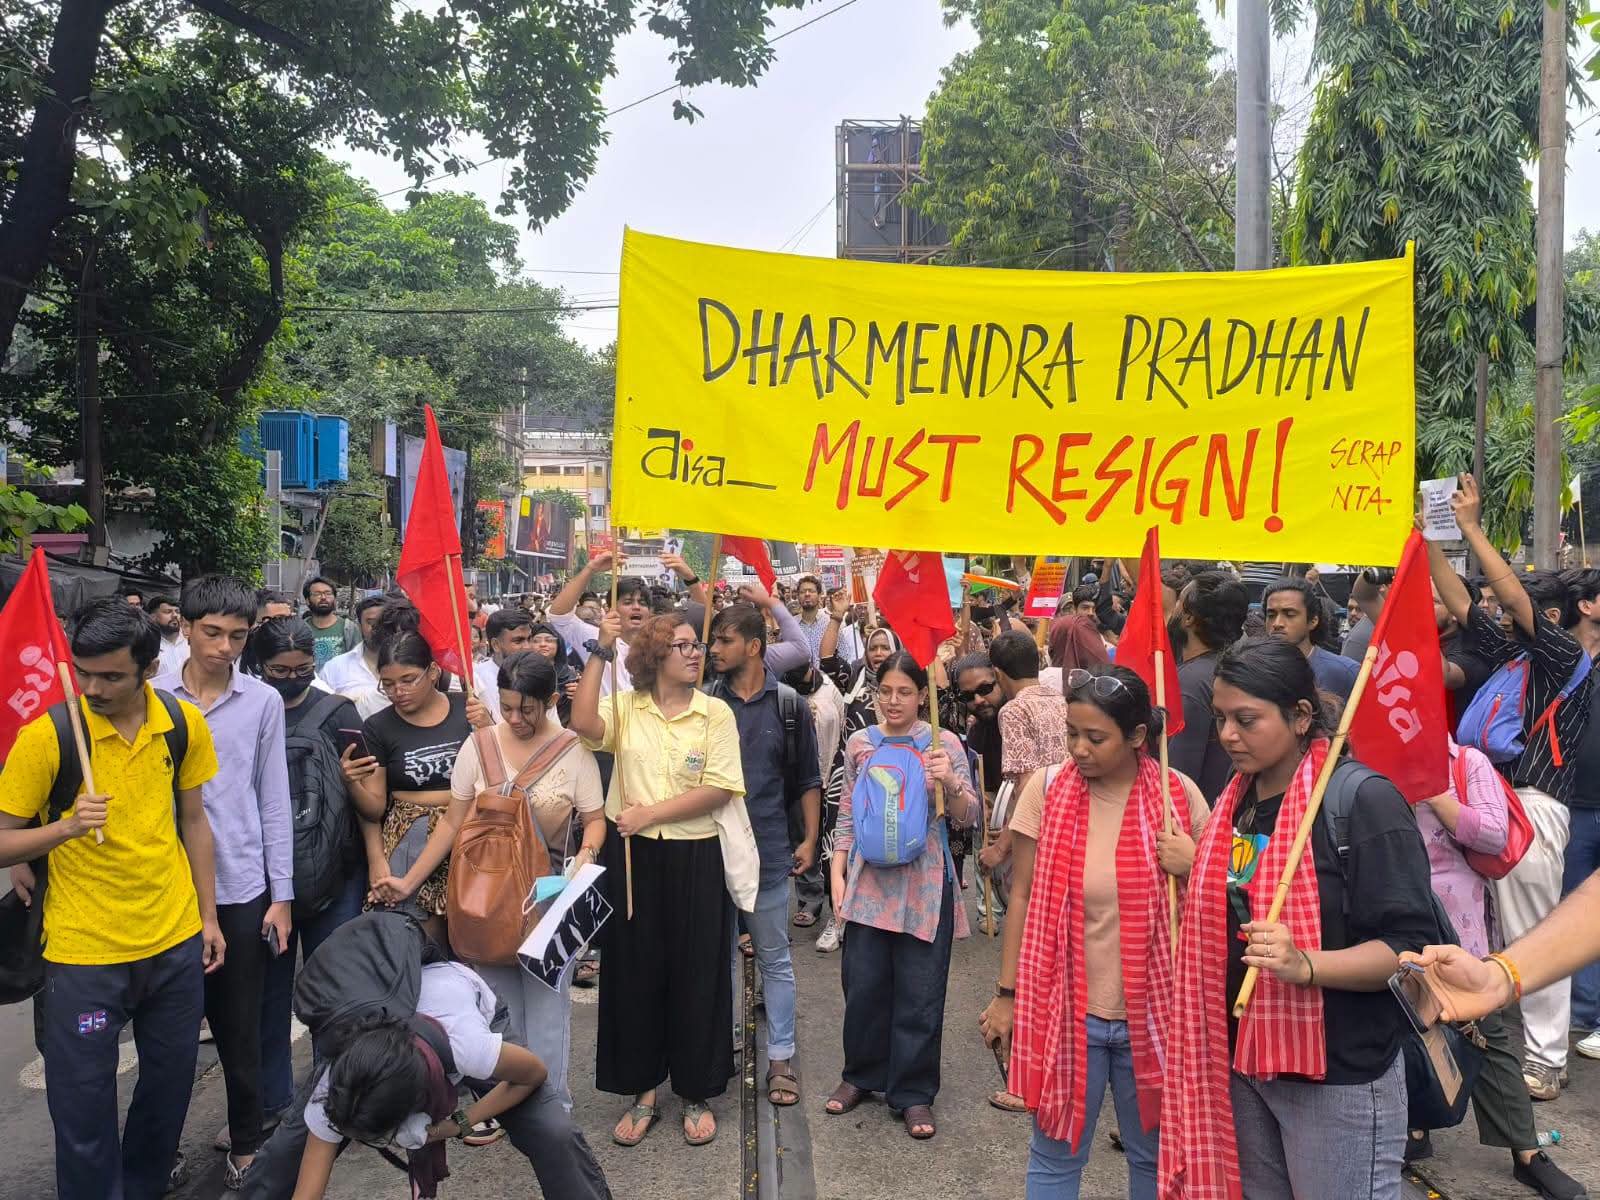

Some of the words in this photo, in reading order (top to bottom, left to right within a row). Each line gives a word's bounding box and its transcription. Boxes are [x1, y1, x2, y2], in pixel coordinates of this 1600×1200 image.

[697, 297, 1085, 410] DHARMENDRA
[1115, 306, 1370, 410] PRADHAN
[803, 419, 982, 512] MUST
[1006, 416, 1294, 533] RESIGN!
[1330, 438, 1402, 481] SCRAP
[1330, 484, 1393, 515] NTA
